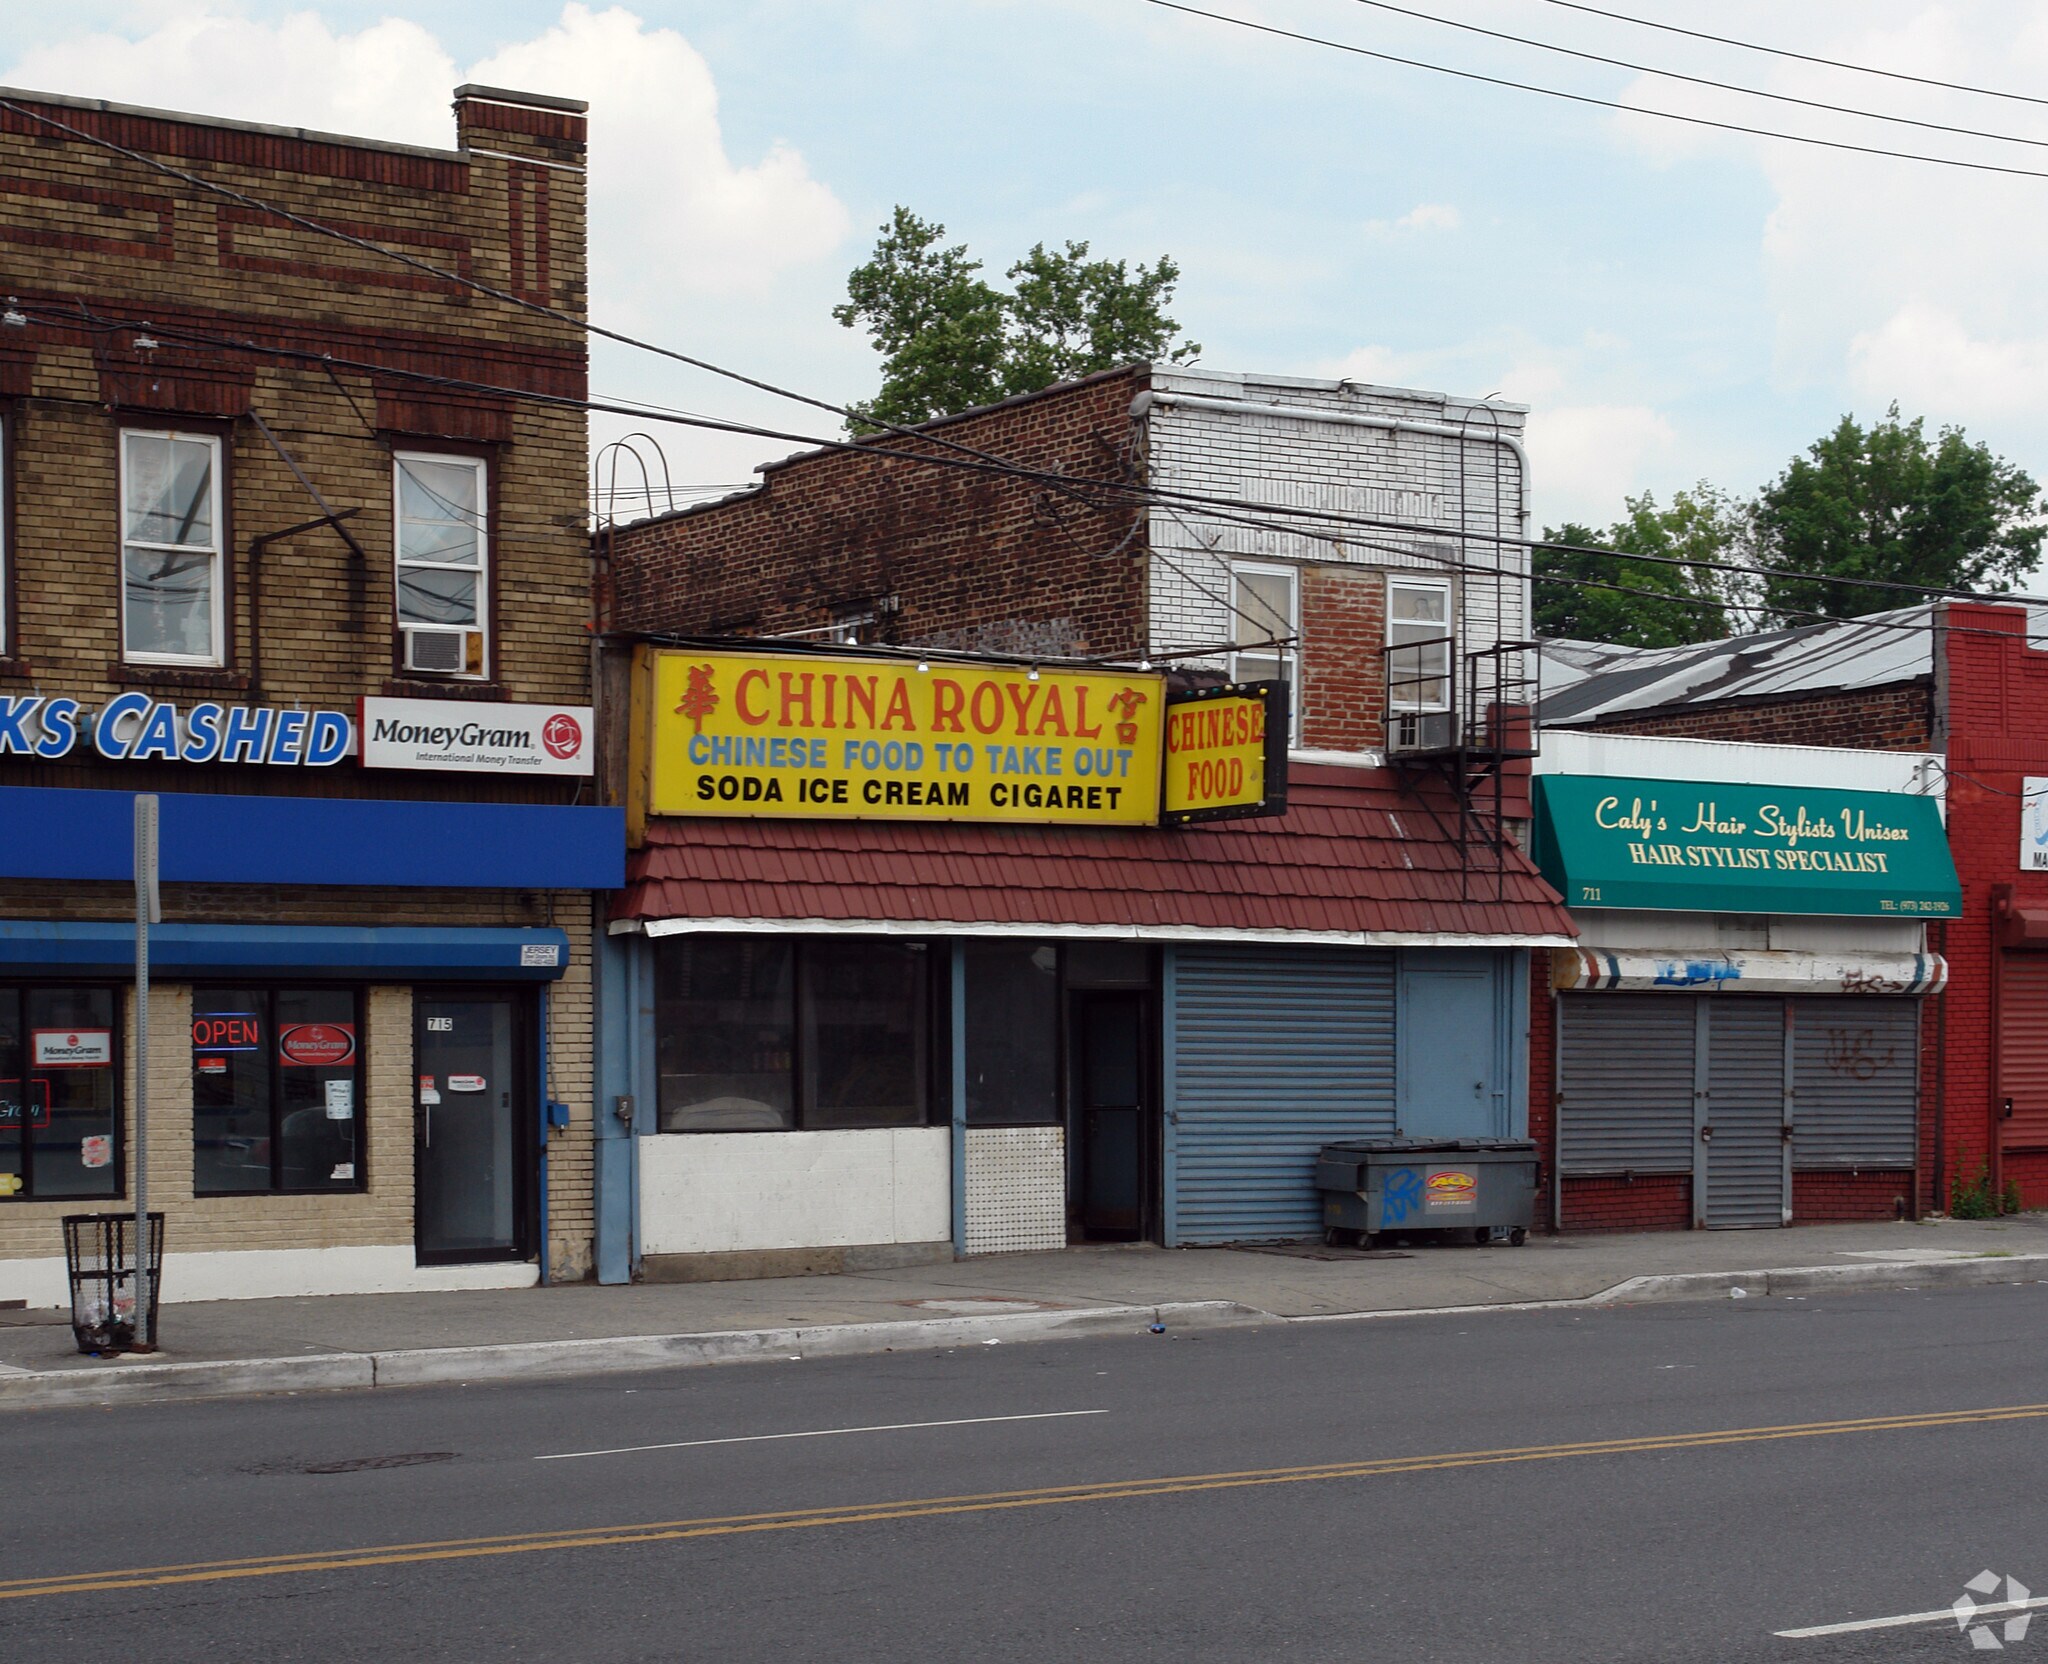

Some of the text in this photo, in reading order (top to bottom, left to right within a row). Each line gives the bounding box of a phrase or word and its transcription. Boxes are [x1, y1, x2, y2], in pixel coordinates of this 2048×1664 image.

[674, 663, 720, 734] 華
[735, 669, 1102, 740] CHINA ROYAL
[0, 691, 352, 767] KS CASHED
[372, 718, 531, 751] MoneyGram
[1167, 703, 1264, 753] CHINESE
[416, 752, 543, 767] International Money Transfer
[688, 734, 1133, 777] CHINESE FOOD TO TAKE OUT
[697, 775, 1121, 810] SODA ICE CREAM CIGARET
[1188, 757, 1243, 801] FOOD
[1595, 796, 1909, 847] Caly's Hair Stylists Unisex
[1627, 843, 1889, 873] HAIR STYLIST SPECIALIST
[1582, 887, 1601, 901] 711
[524, 946, 557, 954] JERSEY
[192, 1020, 258, 1045] OPEN
[429, 1018, 452, 1030] 715
